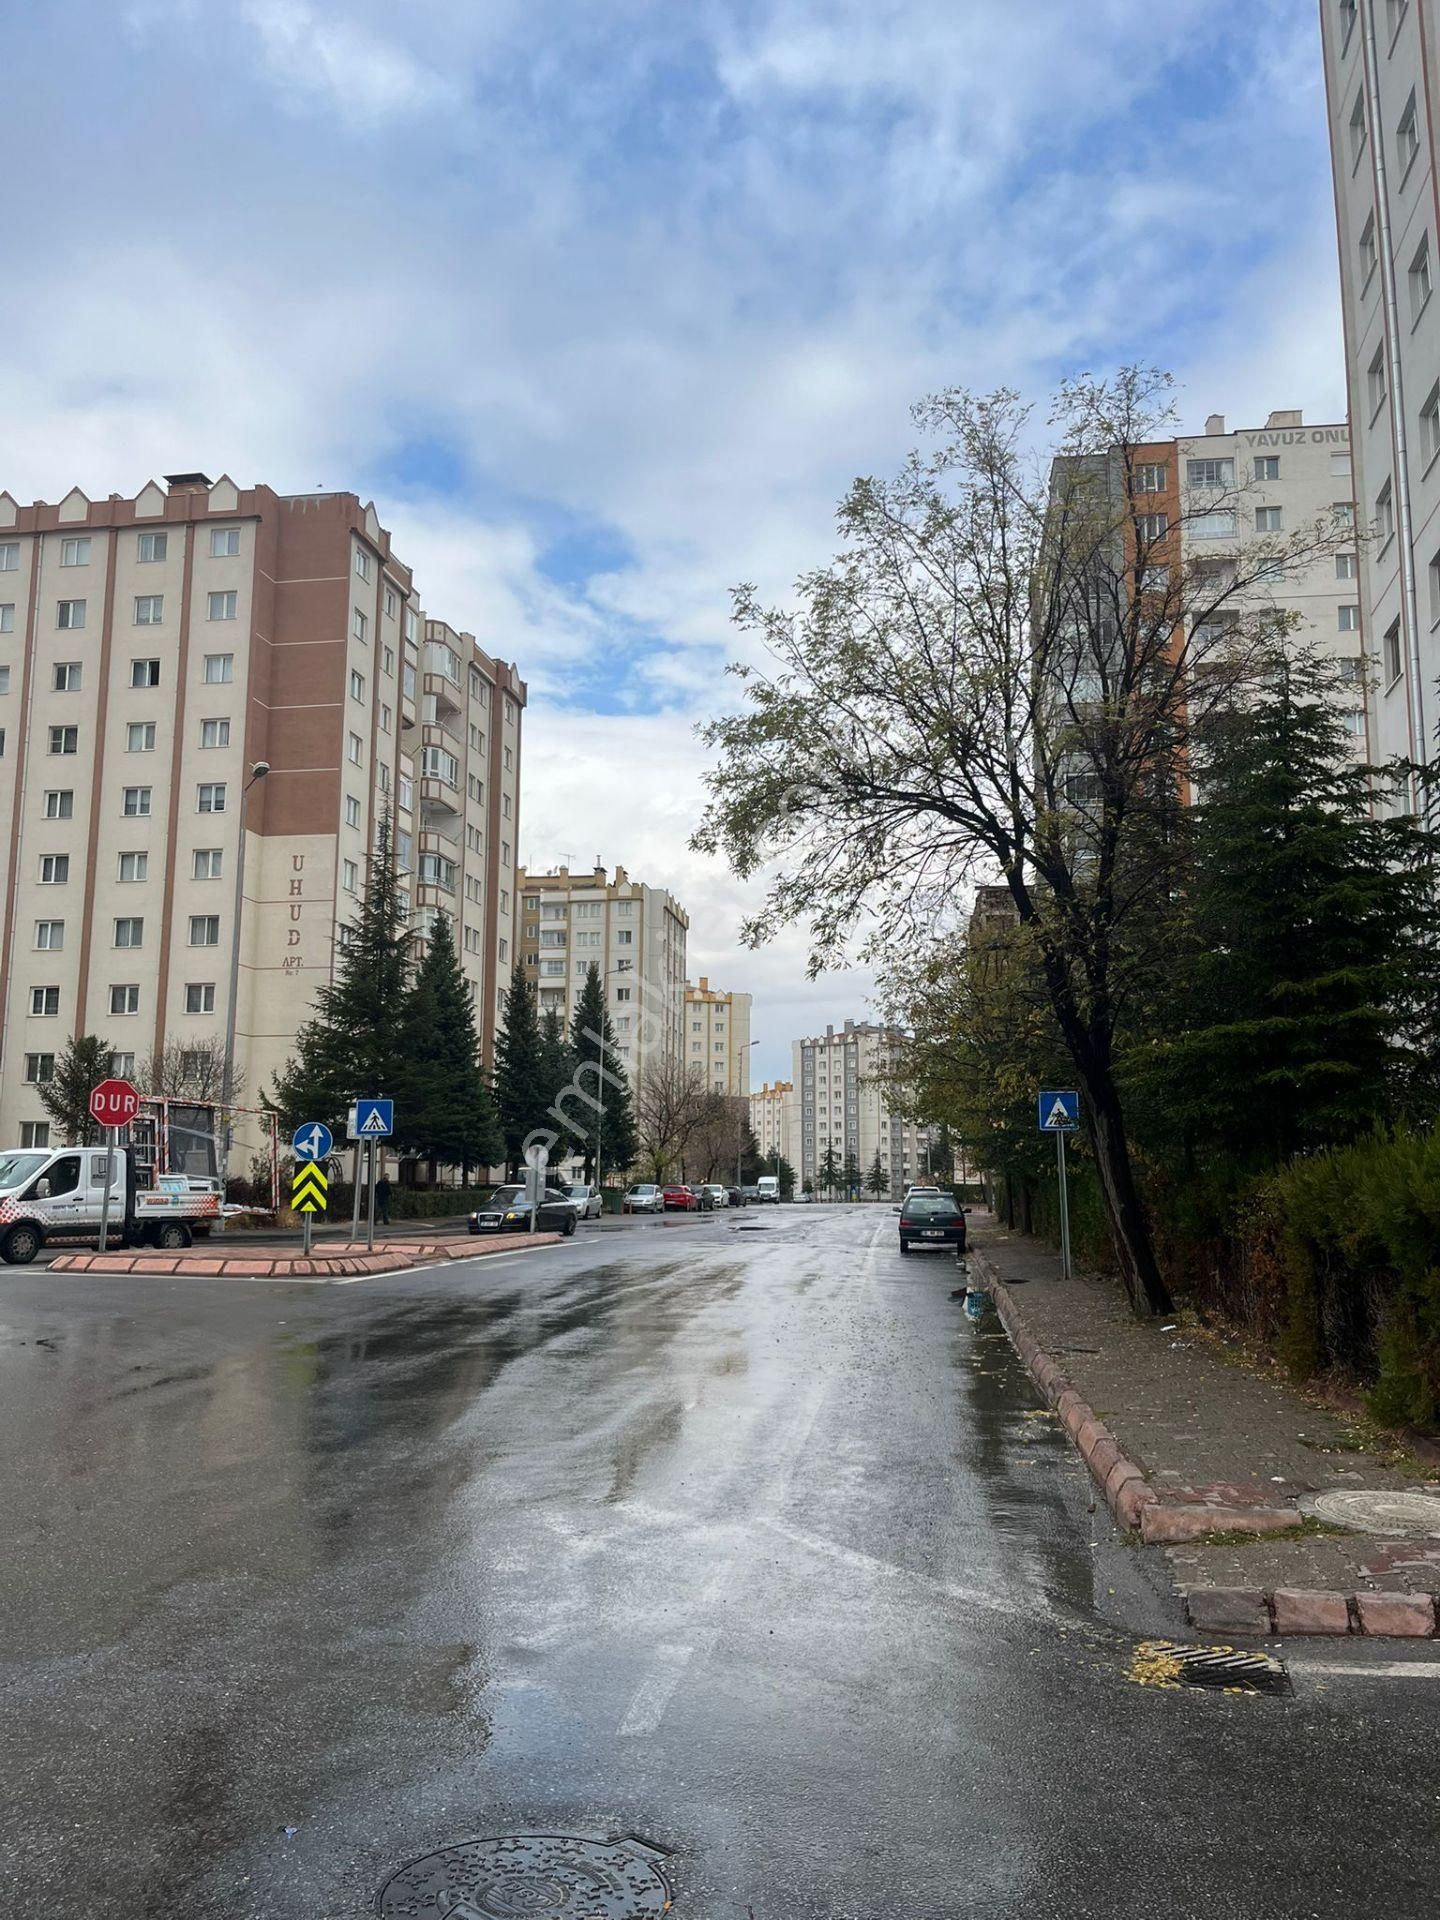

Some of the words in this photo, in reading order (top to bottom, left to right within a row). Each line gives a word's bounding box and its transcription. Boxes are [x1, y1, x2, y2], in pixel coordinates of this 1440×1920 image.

[1245, 431, 1306, 448] YAVUZ
[287, 855, 304, 946] UHUD
[282, 956, 304, 967] APT.
[94, 1093, 135, 1112] DUR
